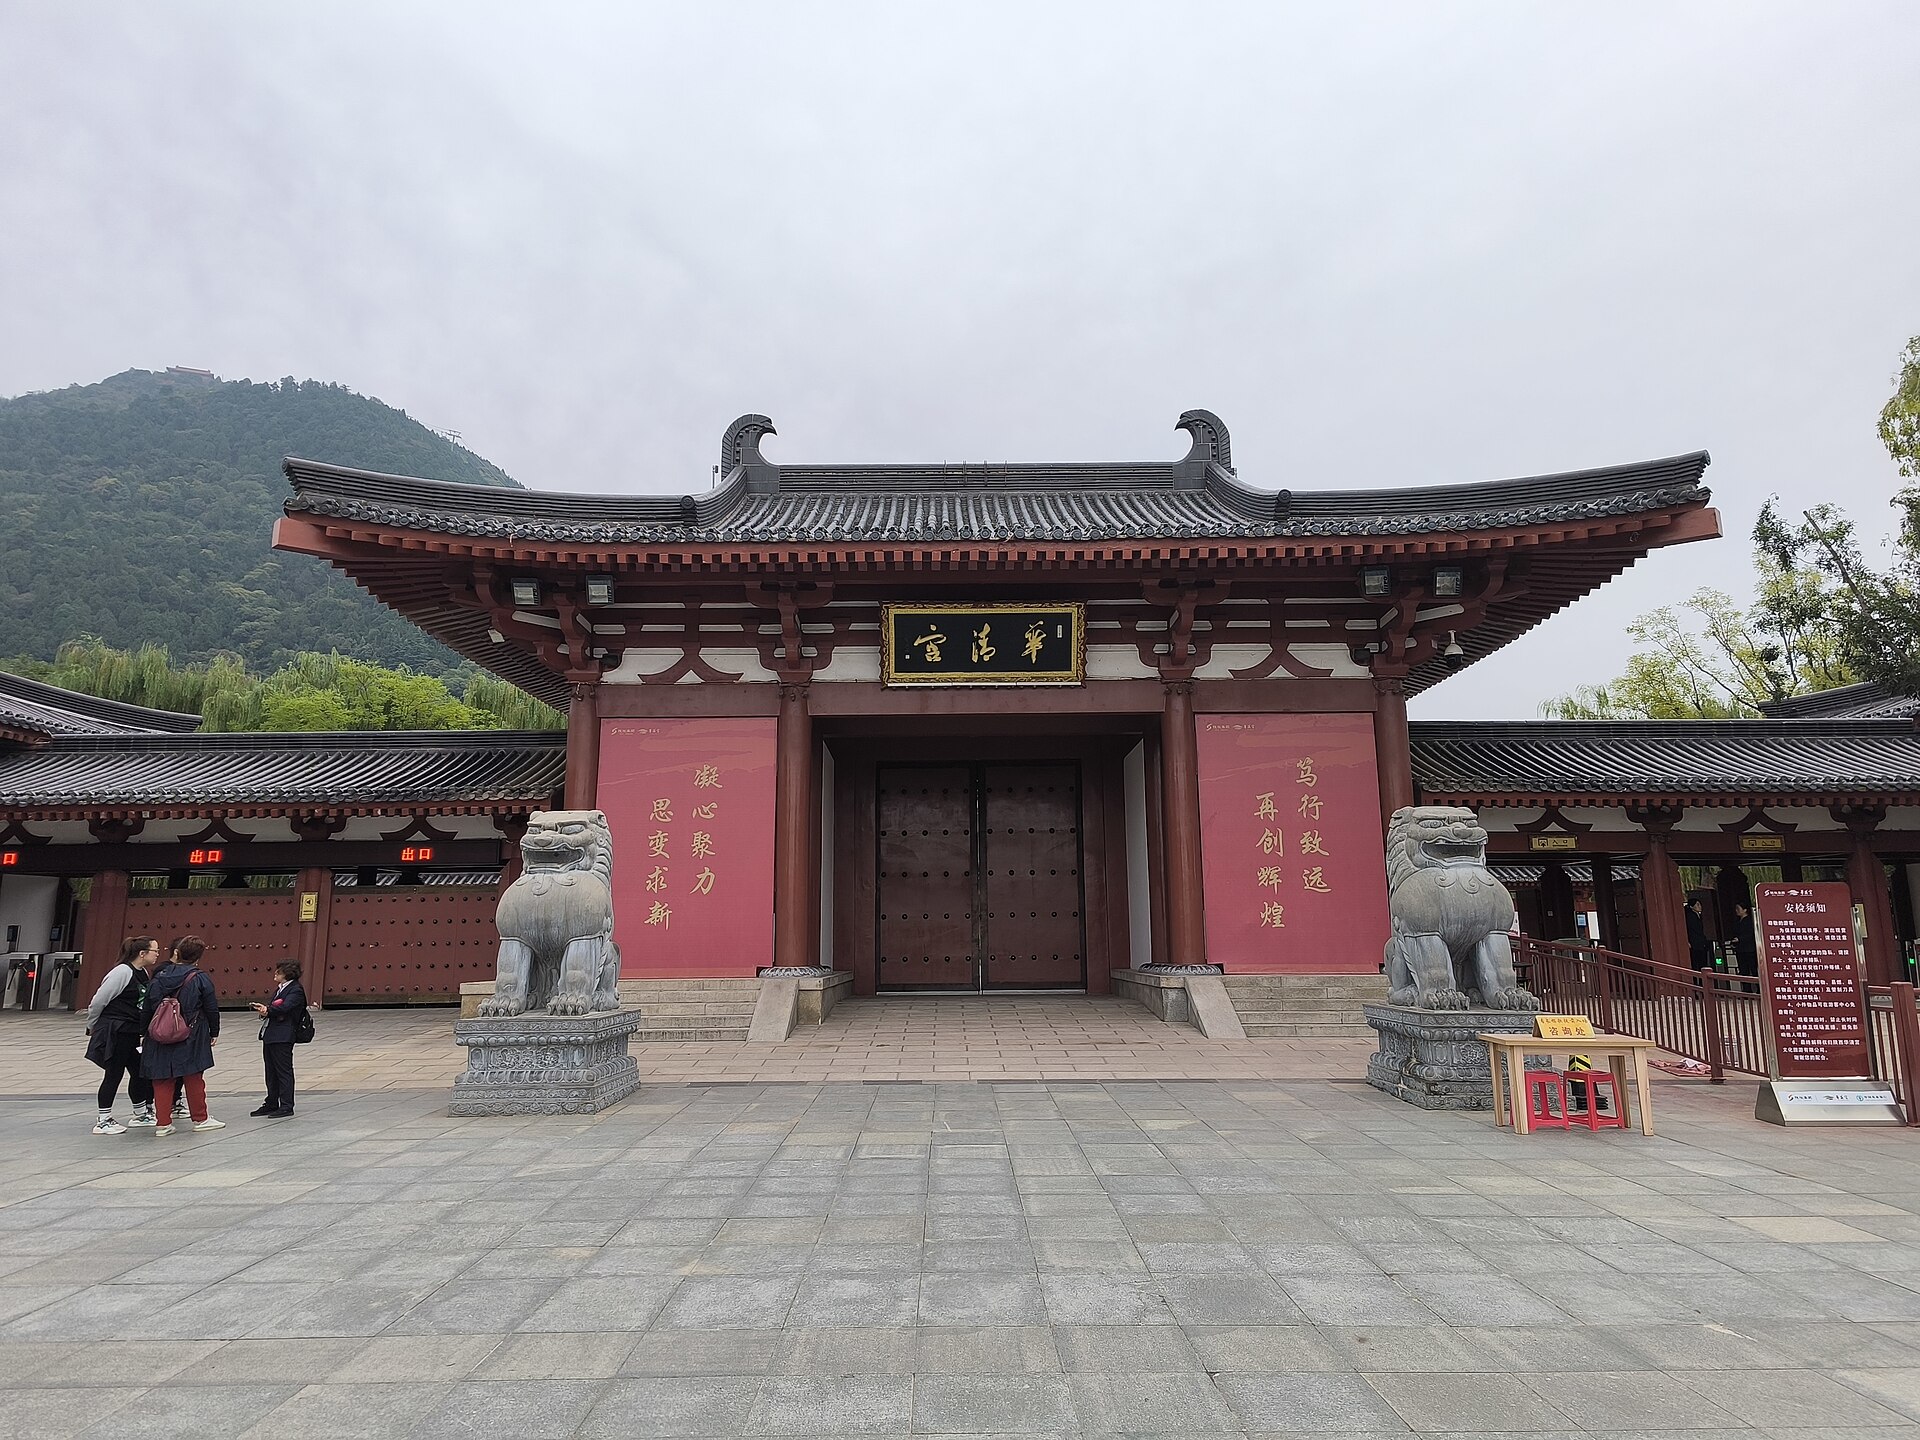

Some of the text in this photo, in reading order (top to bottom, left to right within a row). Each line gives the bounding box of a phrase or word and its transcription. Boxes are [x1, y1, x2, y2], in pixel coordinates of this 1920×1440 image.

[189, 849, 222, 864] 出口
[401, 847, 432, 862] 出口
[689, 764, 724, 895] 凝心聚力
[1253, 791, 1286, 929] 再创辉煌
[1295, 756, 1333, 893] 笃行致远
[643, 798, 674, 931] 思变求新
[1784, 902, 1826, 913] 安检须知
[1549, 1026, 1586, 1036] 咨询处
